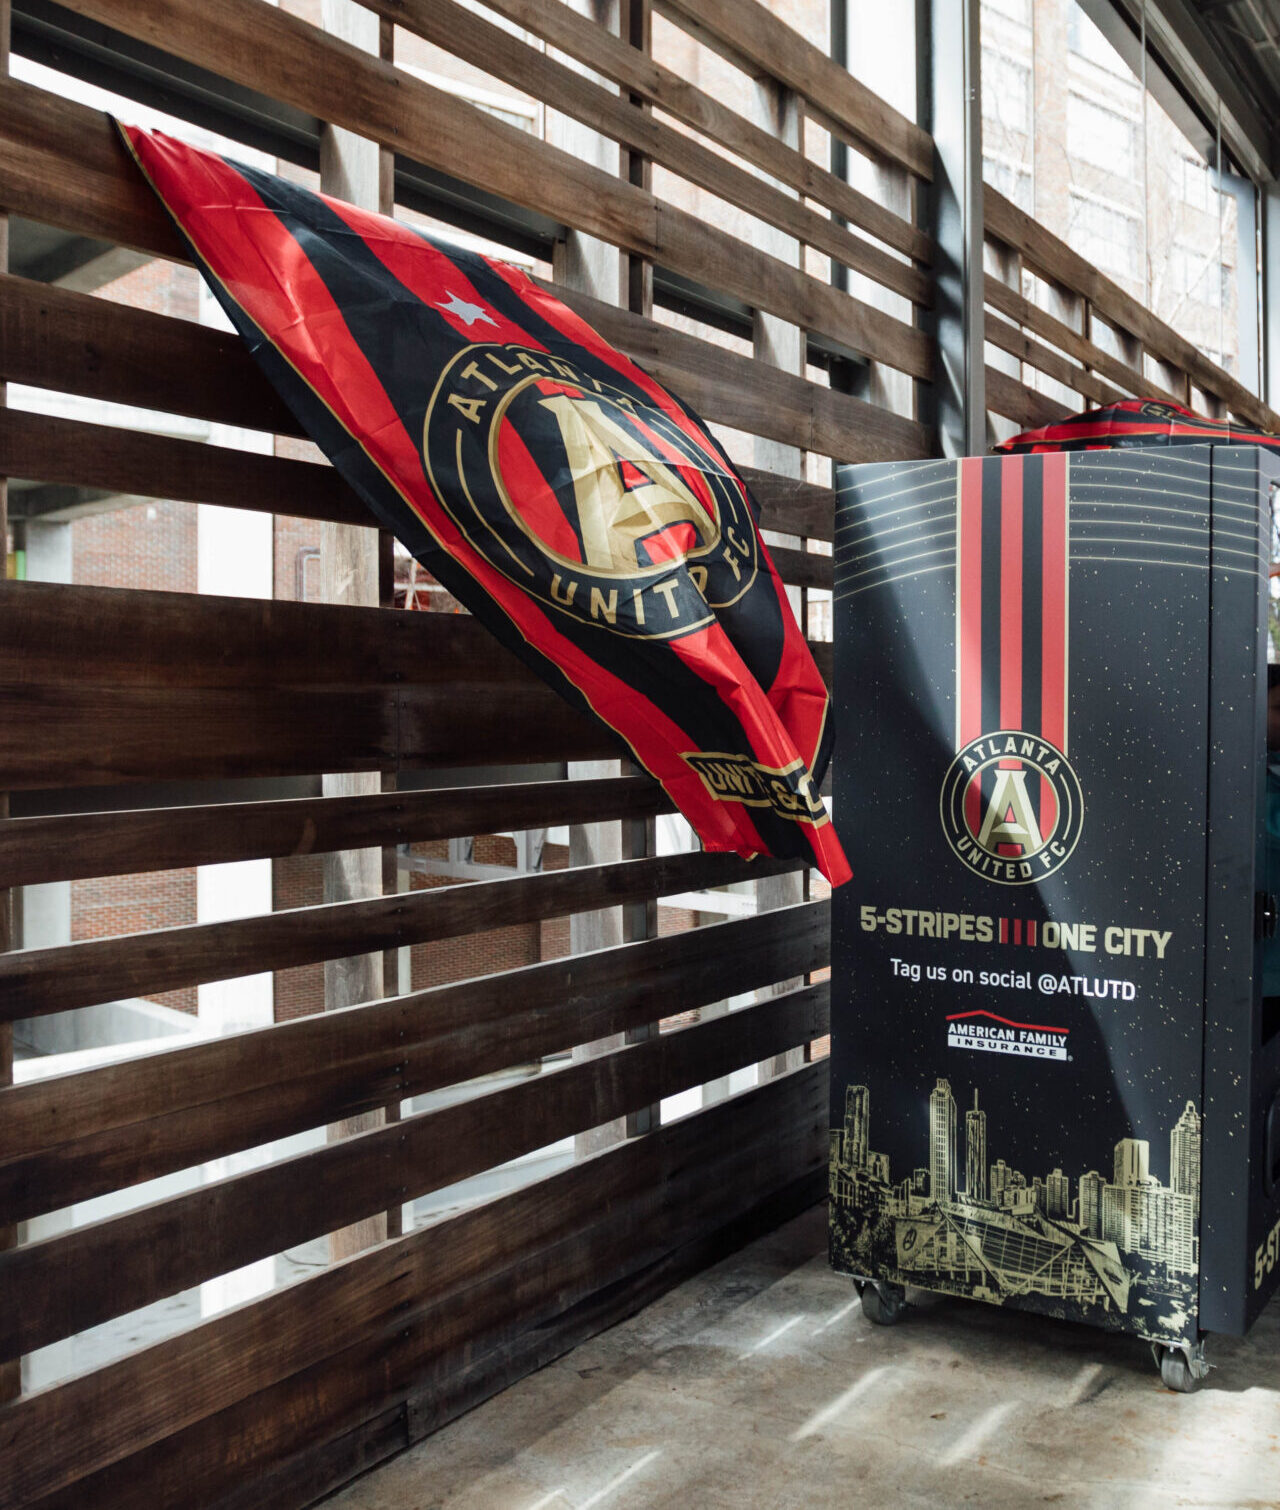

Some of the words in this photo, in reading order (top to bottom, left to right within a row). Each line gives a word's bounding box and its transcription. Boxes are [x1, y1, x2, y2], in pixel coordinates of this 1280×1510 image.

[550, 565, 708, 625] UNITD
[962, 737, 1062, 776] ATLANTA
[956, 835, 1032, 879] UNITED
[1038, 841, 1066, 869] FC
[860, 905, 993, 943] 5-STRIPES
[1042, 921, 1097, 953] ONE
[1104, 926, 1173, 959] CITY
[890, 958, 921, 981] Tag
[926, 966, 947, 980] us
[952, 970, 974, 984] on
[979, 970, 1032, 990] social
[1038, 974, 1136, 1001] @ATLUTD
[948, 1023, 1015, 1041] AMERICAN
[1020, 1031, 1067, 1047] FAMILY
[957, 1038, 1057, 1057] INSURANCE
